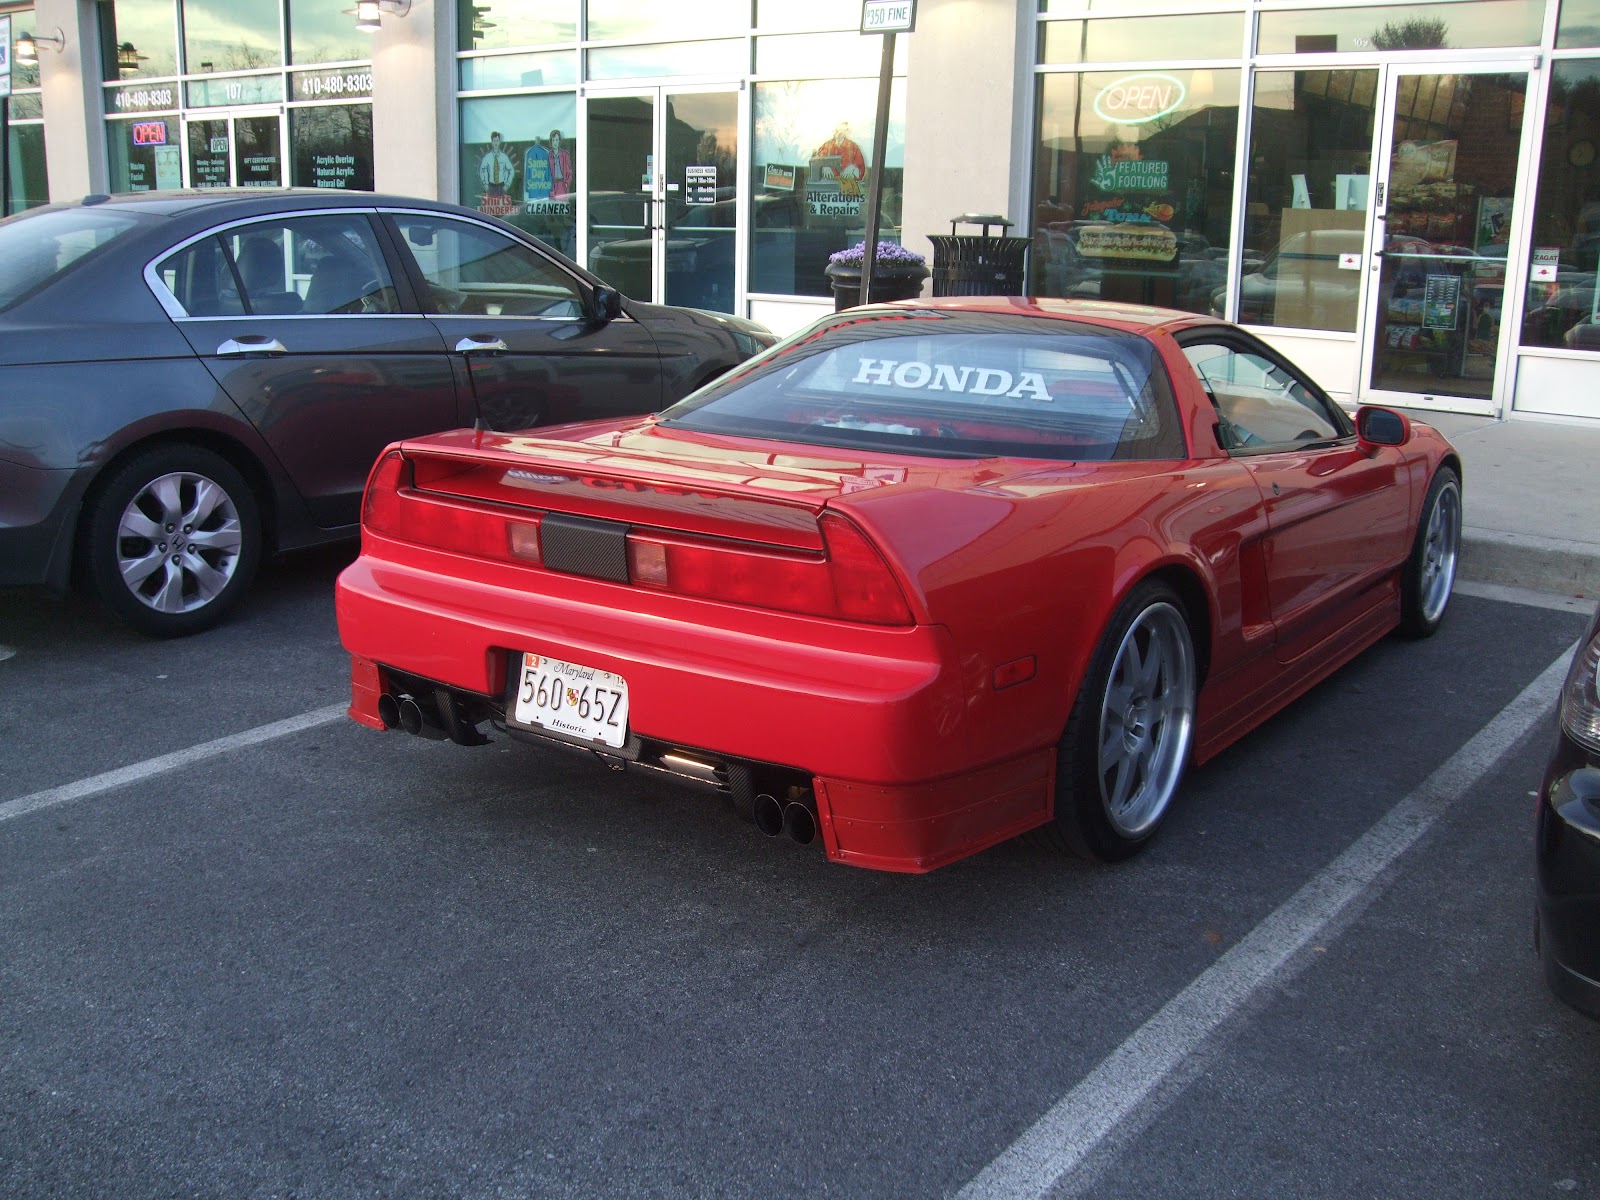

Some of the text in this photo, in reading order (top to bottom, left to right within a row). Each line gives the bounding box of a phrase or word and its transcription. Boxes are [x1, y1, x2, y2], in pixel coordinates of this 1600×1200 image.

[867, 7, 908, 24] $350 FINE
[302, 74, 372, 94] 410-480-8303
[225, 83, 242, 100] 107
[1106, 85, 1172, 110] OPEN
[116, 89, 172, 108] 410-480-8303
[134, 124, 164, 143] OPEN
[212, 140, 228, 150] OPEN
[316, 155, 354, 165] Acrylic Overlay
[528, 158, 548, 168] Same
[336, 167, 354, 176] Acrylic
[1119, 162, 1167, 174] FEATURED
[532, 169, 545, 180] Day
[527, 181, 551, 189] Service
[1118, 176, 1166, 188] FOOTLONG
[482, 193, 512, 206] Shirts
[806, 191, 865, 202] Alterations
[526, 204, 570, 215] CLEANERS
[810, 204, 859, 219] & Repairs
[852, 358, 1054, 401] HONDA
[531, 656, 536, 666] 2
[554, 663, 595, 680] Maryland
[616, 676, 624, 685] 14
[523, 670, 622, 726] 560 65Z
[552, 719, 586, 734] Historic
